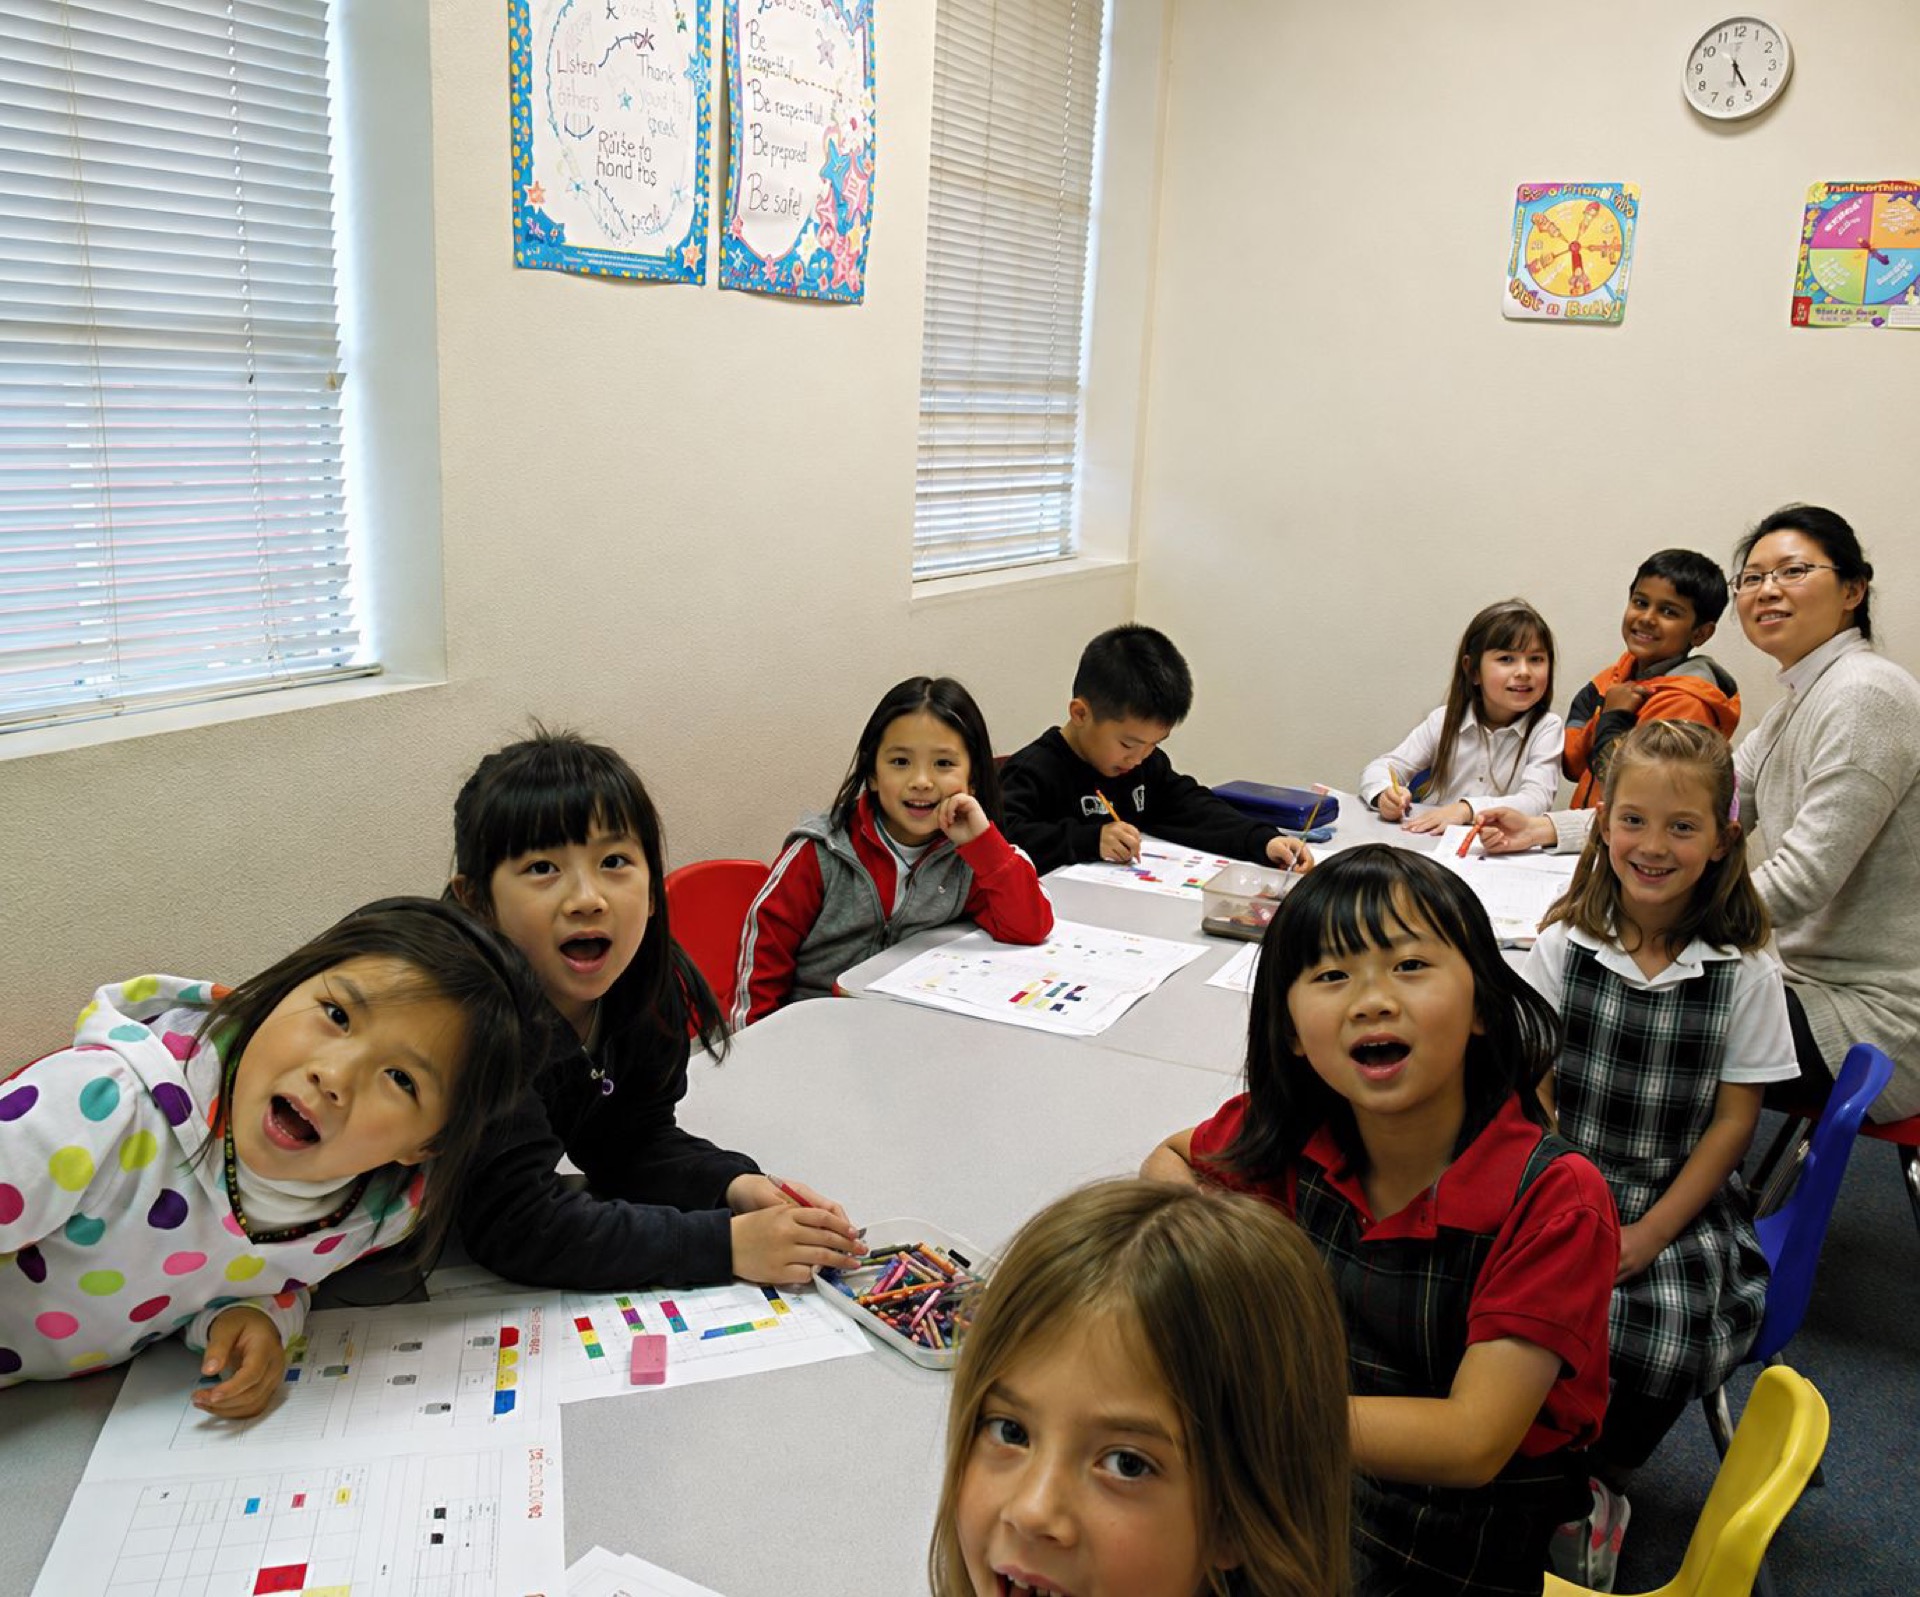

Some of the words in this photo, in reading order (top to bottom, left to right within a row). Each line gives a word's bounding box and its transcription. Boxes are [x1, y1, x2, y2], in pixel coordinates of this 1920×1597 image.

[1734, 25, 1747, 37] 12
[1718, 32, 1728, 43] 11
[1703, 45, 1716, 58] 10
[1764, 41, 1773, 53] 2
[1695, 63, 1704, 75] 9
[1768, 59, 1777, 71] 3
[1698, 80, 1706, 91] 8
[1760, 77, 1768, 88] 4
[1711, 91, 1719, 103] 7
[1726, 96, 1734, 107] 6
[1744, 90, 1752, 102] 5
[750, 122, 768, 156] Be
[747, 172, 769, 211] Be
